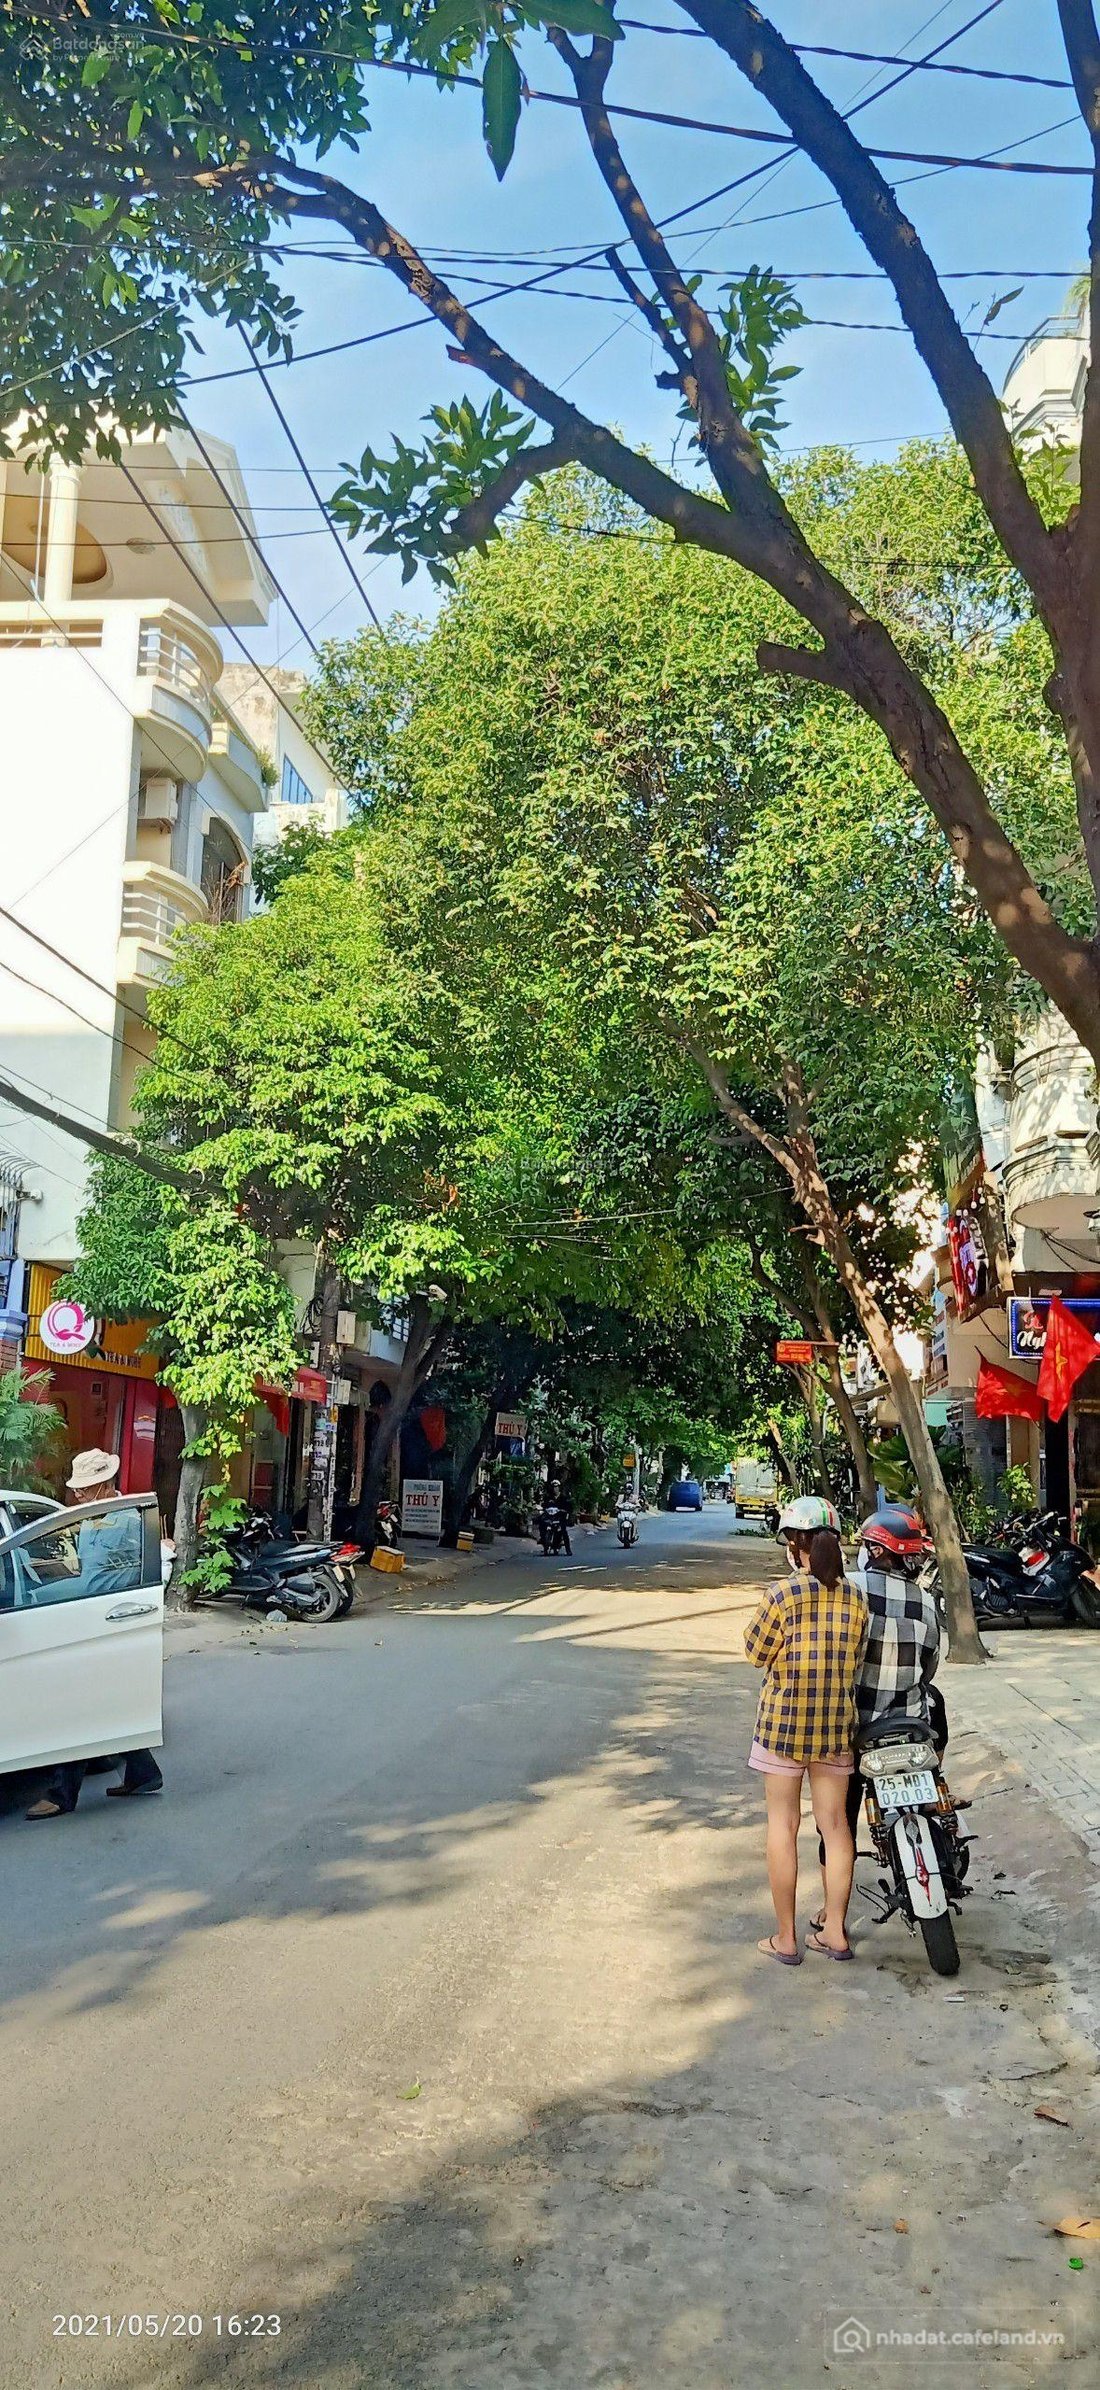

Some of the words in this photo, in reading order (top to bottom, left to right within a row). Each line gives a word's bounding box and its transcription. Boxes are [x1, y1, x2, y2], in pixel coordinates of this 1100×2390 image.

[517, 1423, 523, 1436] Y
[405, 1492, 428, 1507] THÚ
[432, 1495, 440, 1507] Y
[882, 1787, 934, 1806] 020.03
